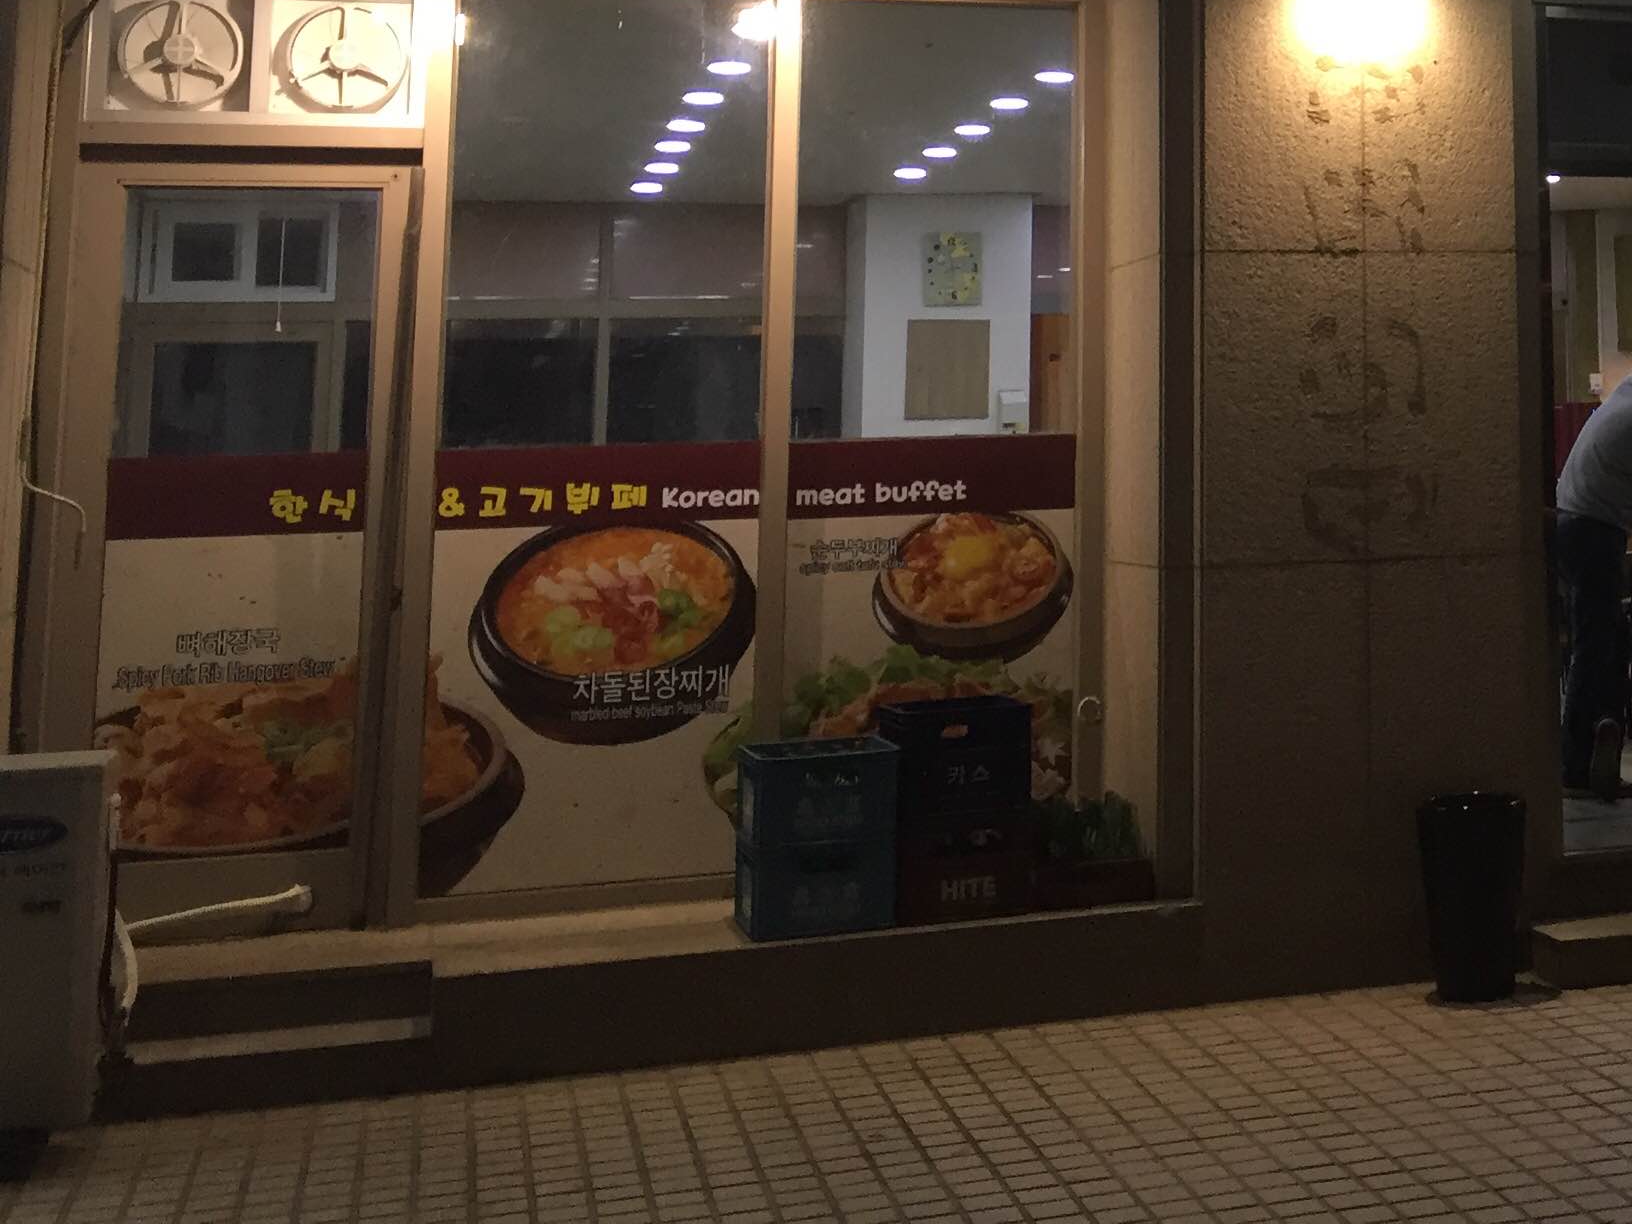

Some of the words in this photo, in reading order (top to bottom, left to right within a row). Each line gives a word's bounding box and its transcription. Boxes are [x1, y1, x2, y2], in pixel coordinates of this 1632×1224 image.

[478, 482, 648, 518] 고기뷔페
[661, 486, 760, 509] Korean
[795, 482, 866, 506] meat
[874, 479, 968, 504] buffet
[572, 664, 730, 704] 차돌된장찌개
